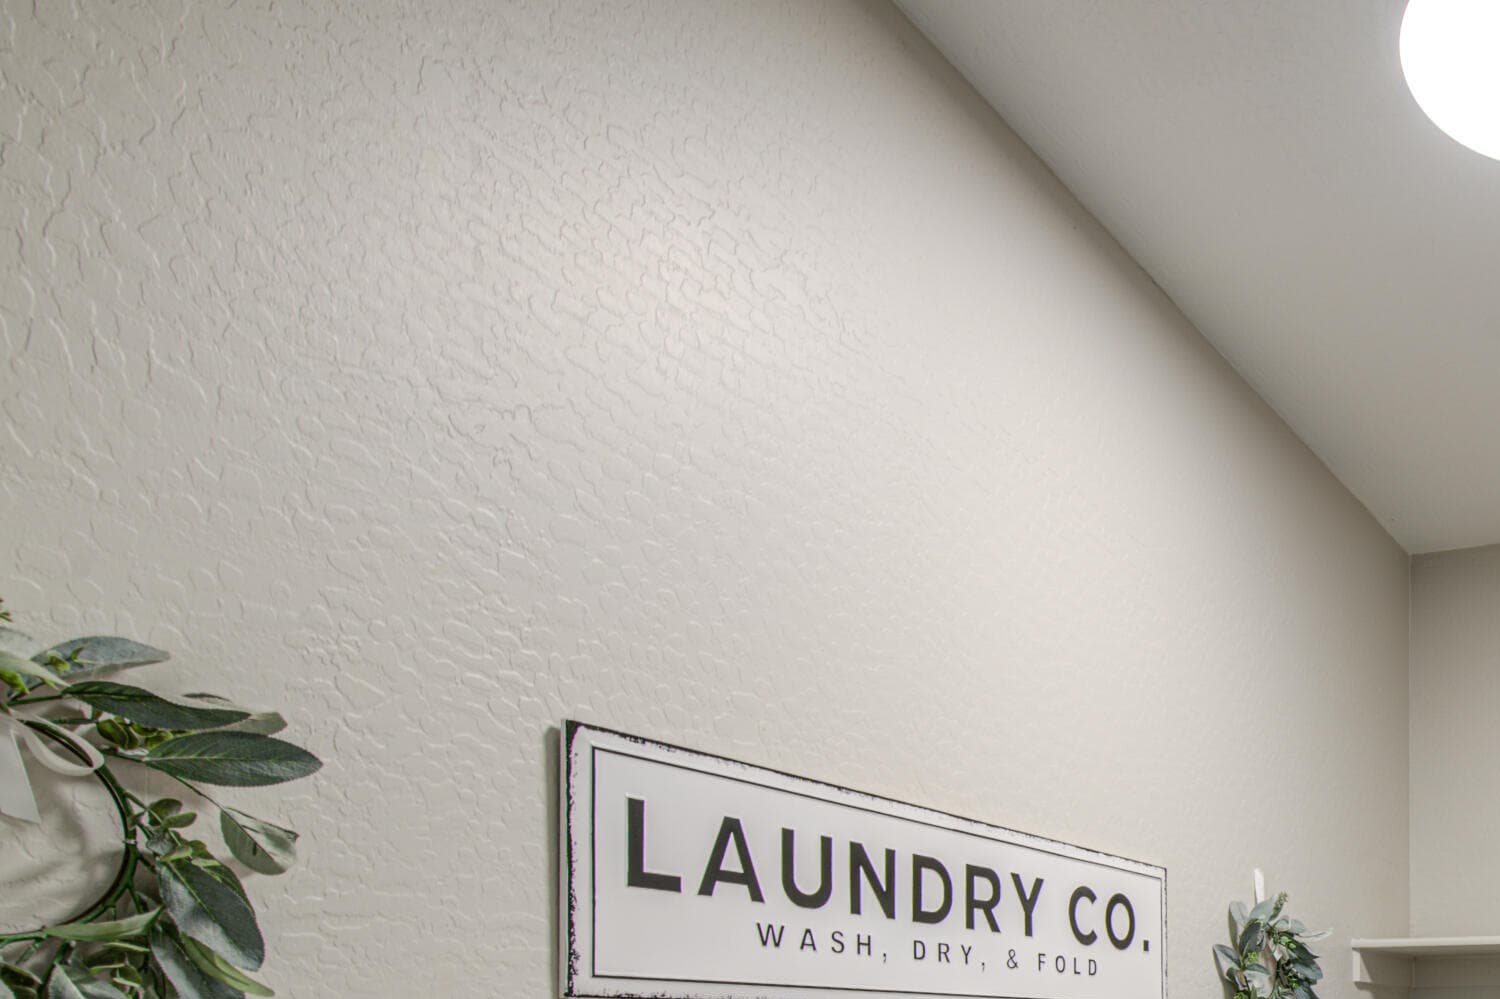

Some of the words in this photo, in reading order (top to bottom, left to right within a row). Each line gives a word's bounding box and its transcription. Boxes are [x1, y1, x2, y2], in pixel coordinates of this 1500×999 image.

[627, 797, 1045, 937] LAUNDRY
[1068, 885, 1150, 952] CO.
[756, 922, 887, 962] WASH,
[913, 939, 986, 971] DRY,
[1006, 948, 1019, 969] &
[1037, 953, 1098, 976] FOLD
